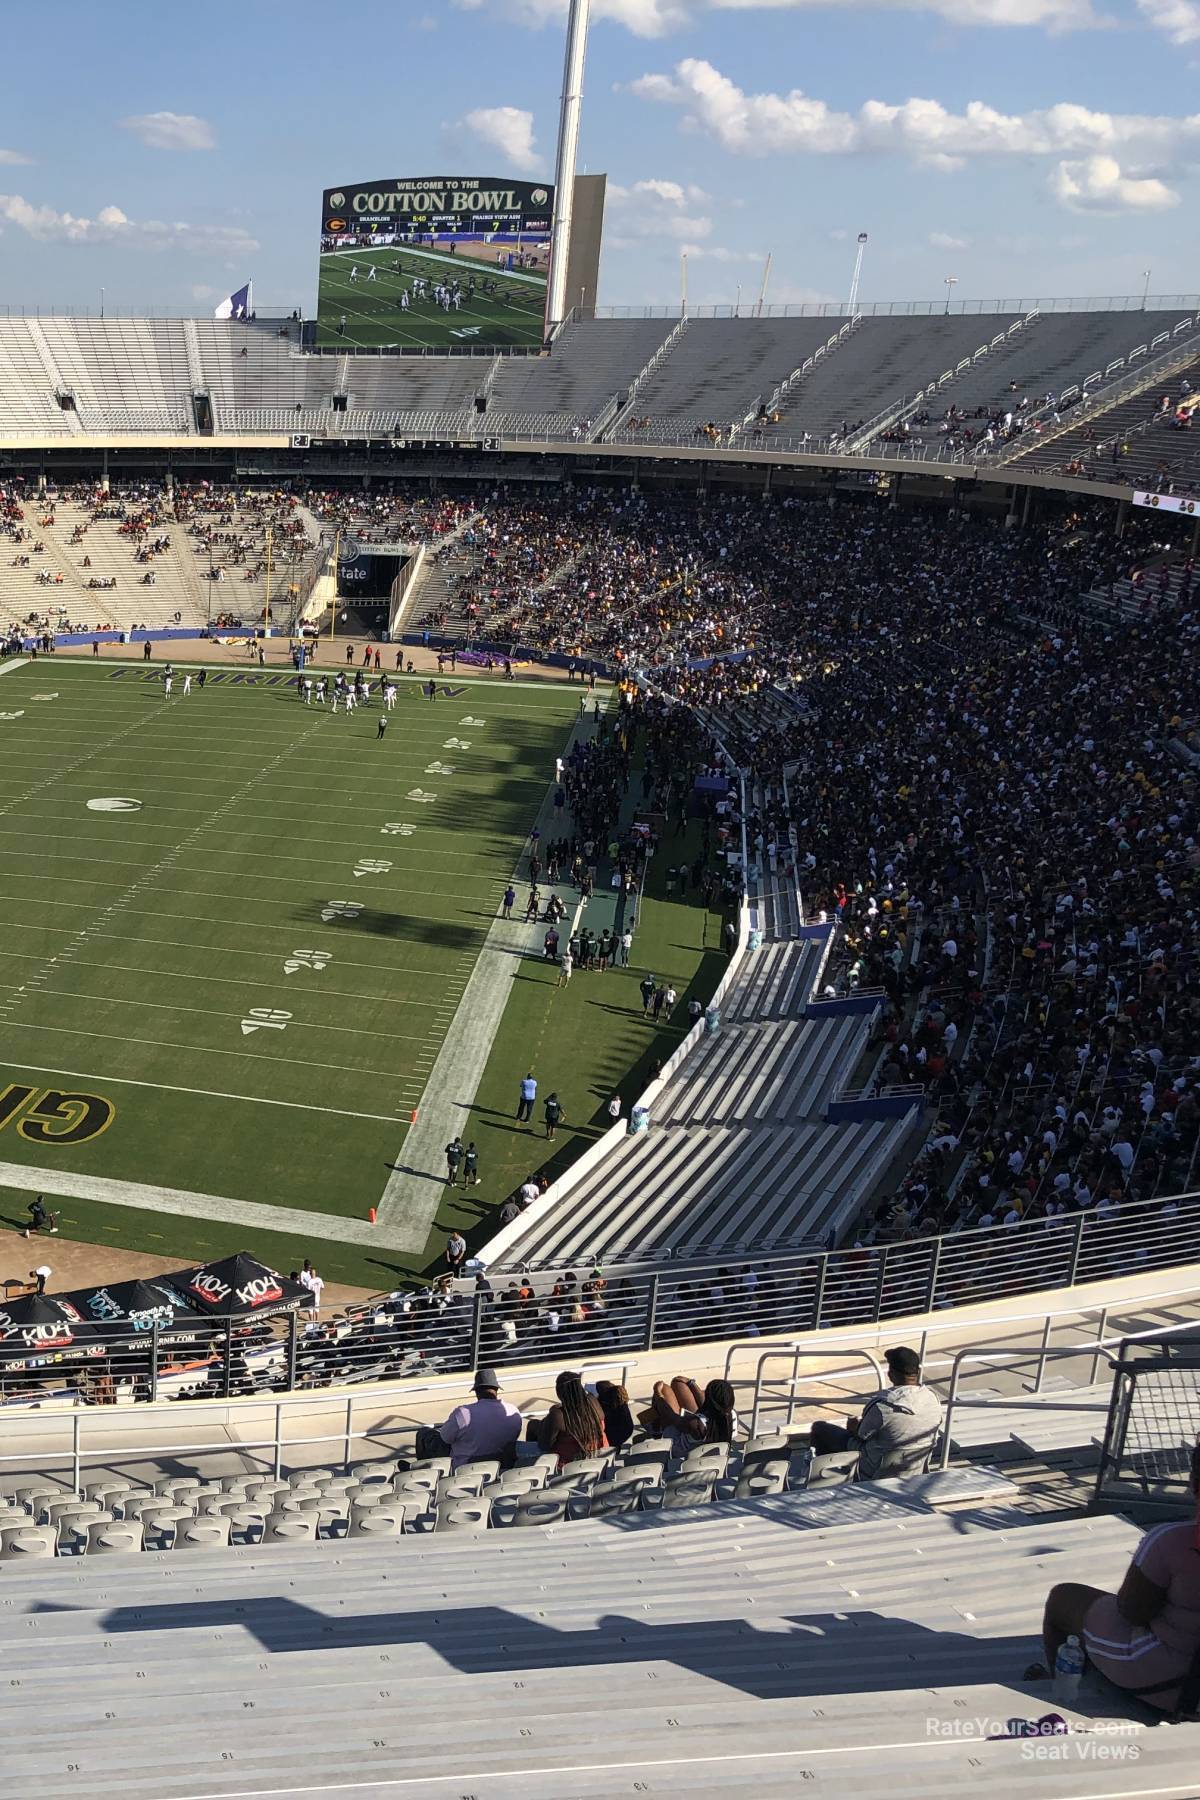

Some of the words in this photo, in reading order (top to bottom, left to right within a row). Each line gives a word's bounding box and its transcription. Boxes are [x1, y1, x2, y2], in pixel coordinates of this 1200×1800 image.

[397, 181, 443, 190] WELCOME
[446, 181, 458, 189] TO
[461, 180, 479, 189] THE
[352, 192, 445, 213] COTTON
[451, 190, 522, 211] BOWL
[371, 223, 378, 232] 7
[492, 221, 500, 231] 7
[294, 435, 308, 446] 21
[485, 439, 499, 449] 21
[380, 822, 417, 836] 50
[353, 859, 394, 874] 40
[321, 900, 366, 918] 30
[284, 949, 333, 971] 20
[241, 1007, 294, 1030] 10
[190, 1271, 232, 1299] K104
[235, 1276, 280, 1304] K104
[128, 1307, 159, 1320] Smooth
[22, 1320, 72, 1346] K104
[128, 1335, 196, 1351] WWW.RNB.COM
[5, 1360, 25, 1371] K104
